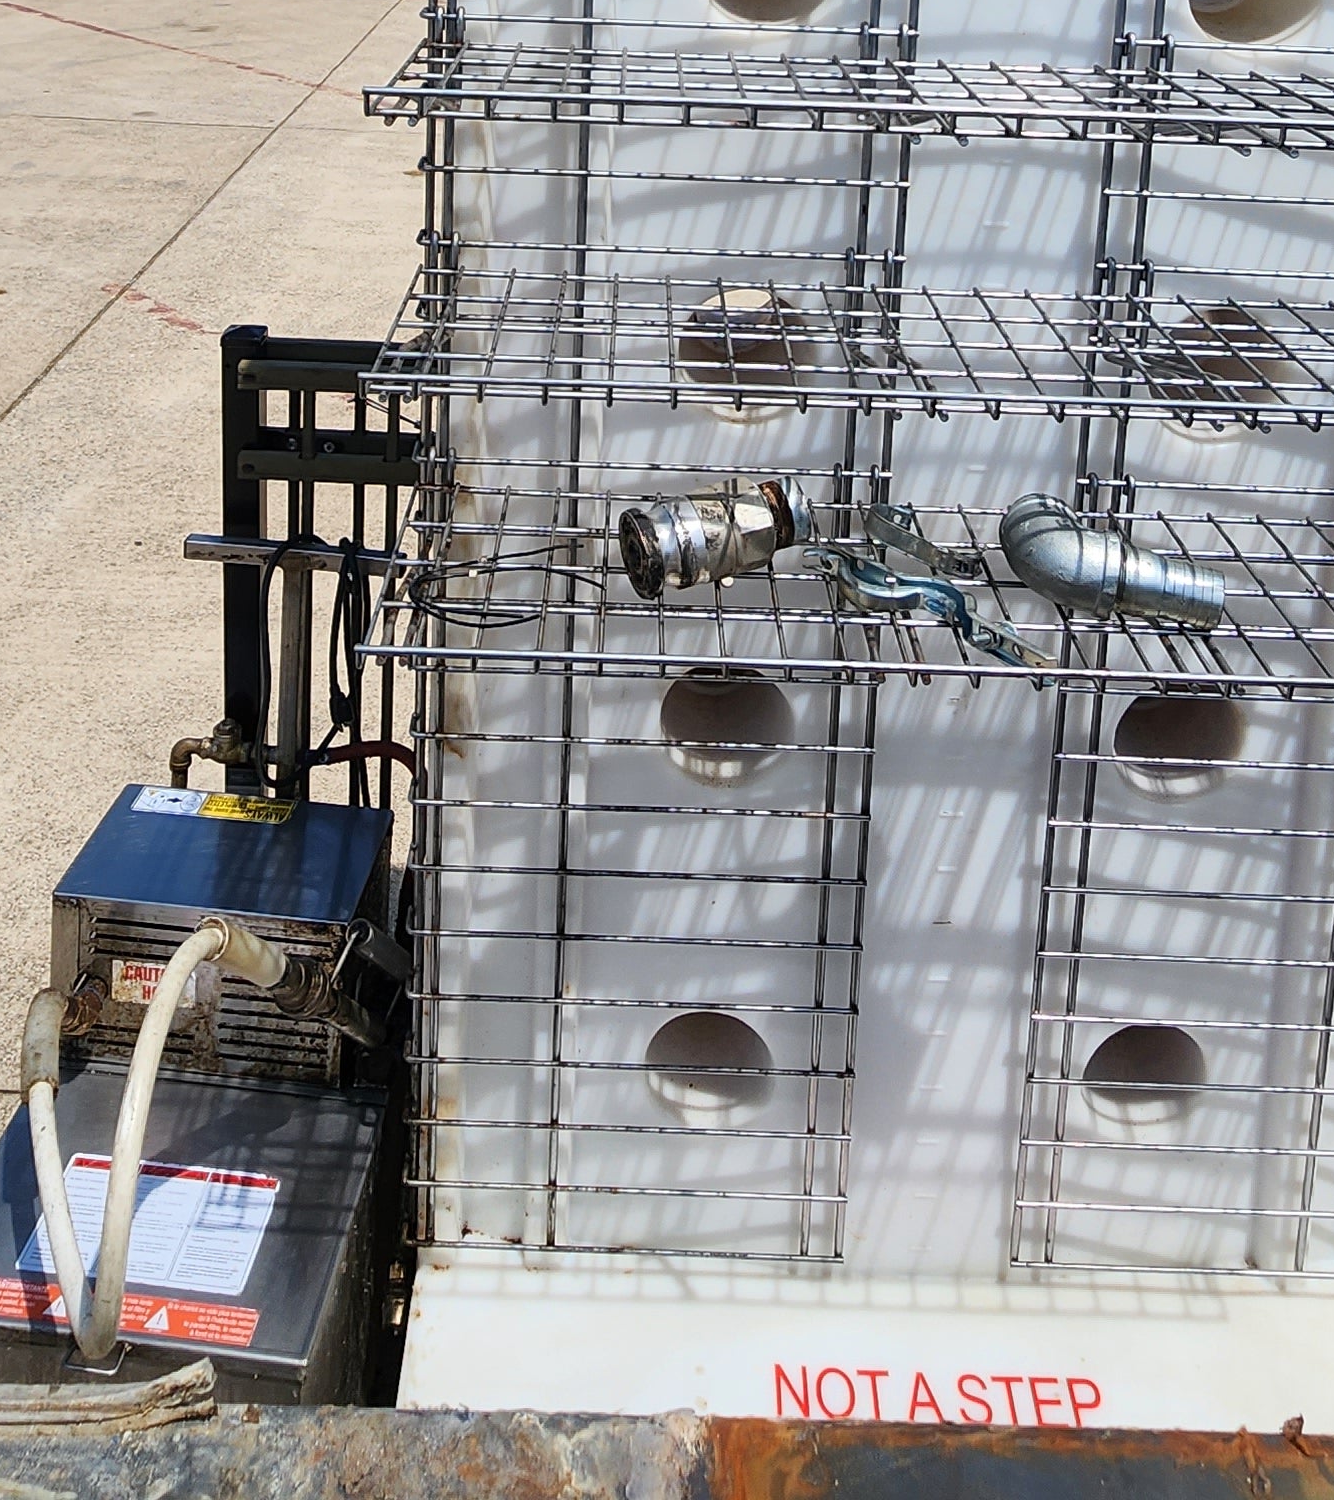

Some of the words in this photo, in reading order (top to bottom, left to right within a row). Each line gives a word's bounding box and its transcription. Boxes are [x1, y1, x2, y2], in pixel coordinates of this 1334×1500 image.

[124, 966, 165, 982] CAUT
[774, 1364, 889, 1420] NOT
[908, 1372, 944, 1423] A
[957, 1374, 1101, 1427] STEP
